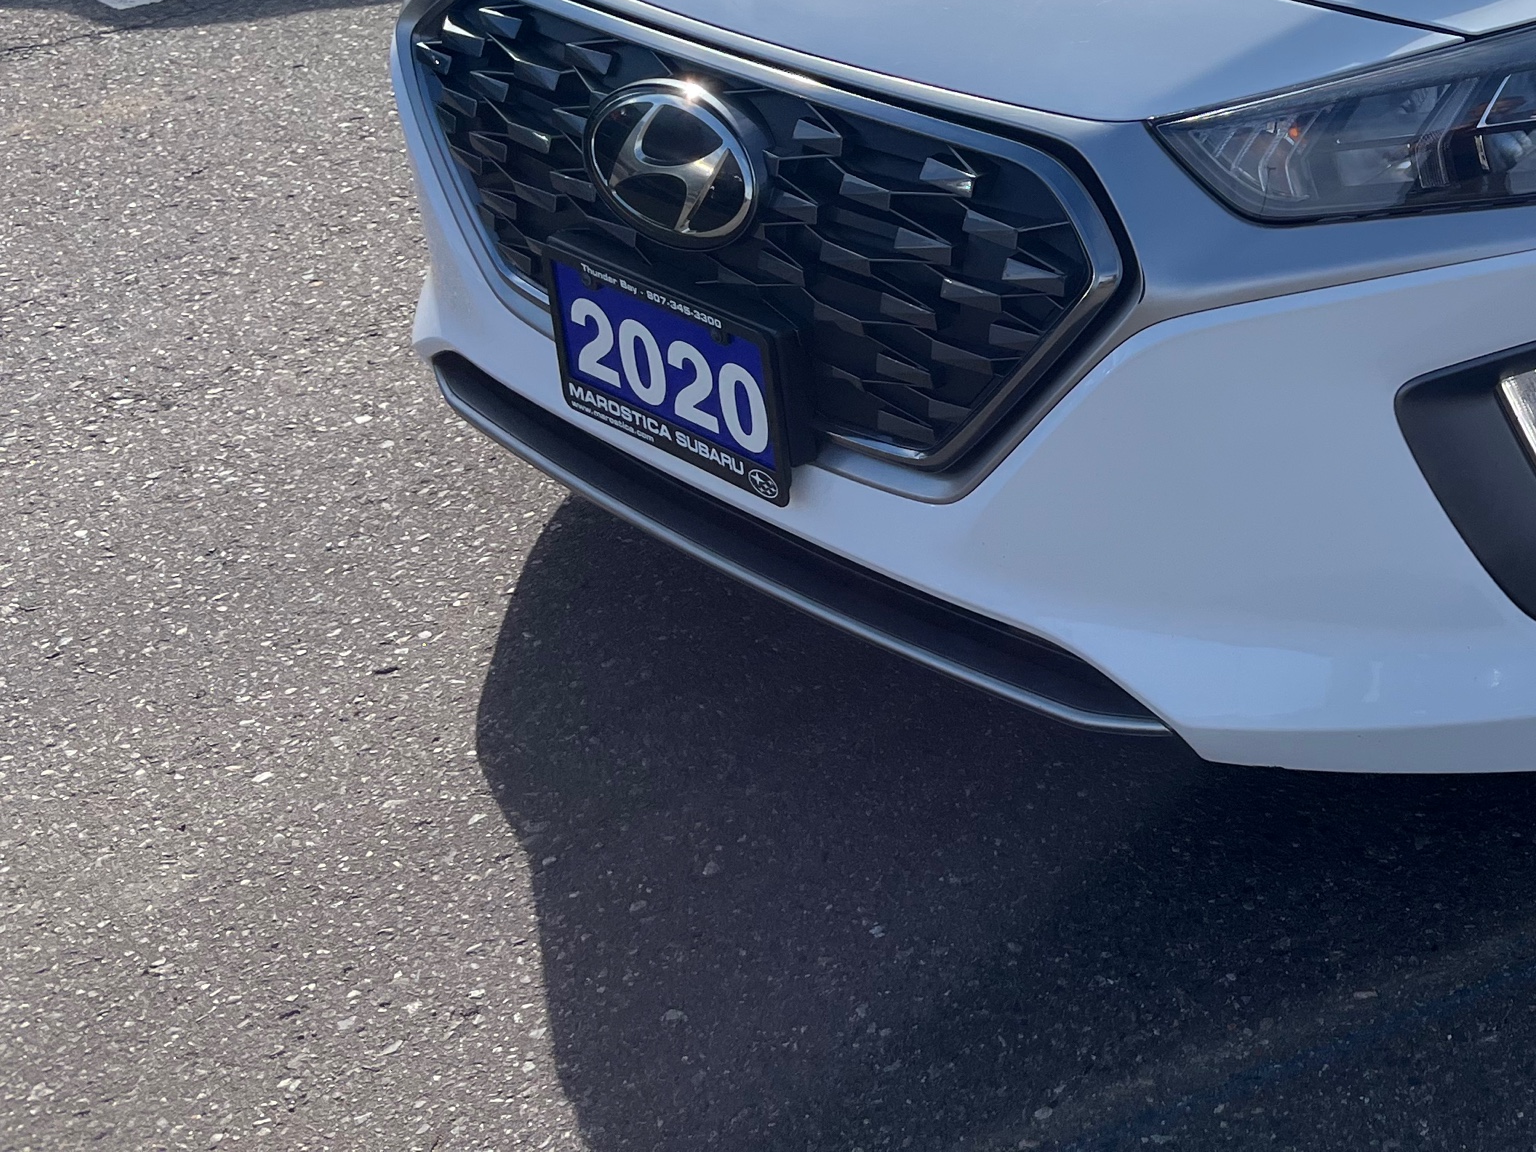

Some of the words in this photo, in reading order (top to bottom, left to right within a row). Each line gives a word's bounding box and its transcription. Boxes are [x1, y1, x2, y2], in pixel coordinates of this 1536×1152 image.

[580, 262, 618, 285] Thunder
[619, 279, 638, 295] Bay
[646, 290, 722, 329] 807-345-3300
[570, 297, 769, 454] 2020
[568, 382, 673, 442] MAROSTICA
[675, 430, 745, 476] SUBARU
[571, 400, 655, 443] www.marostica.com
